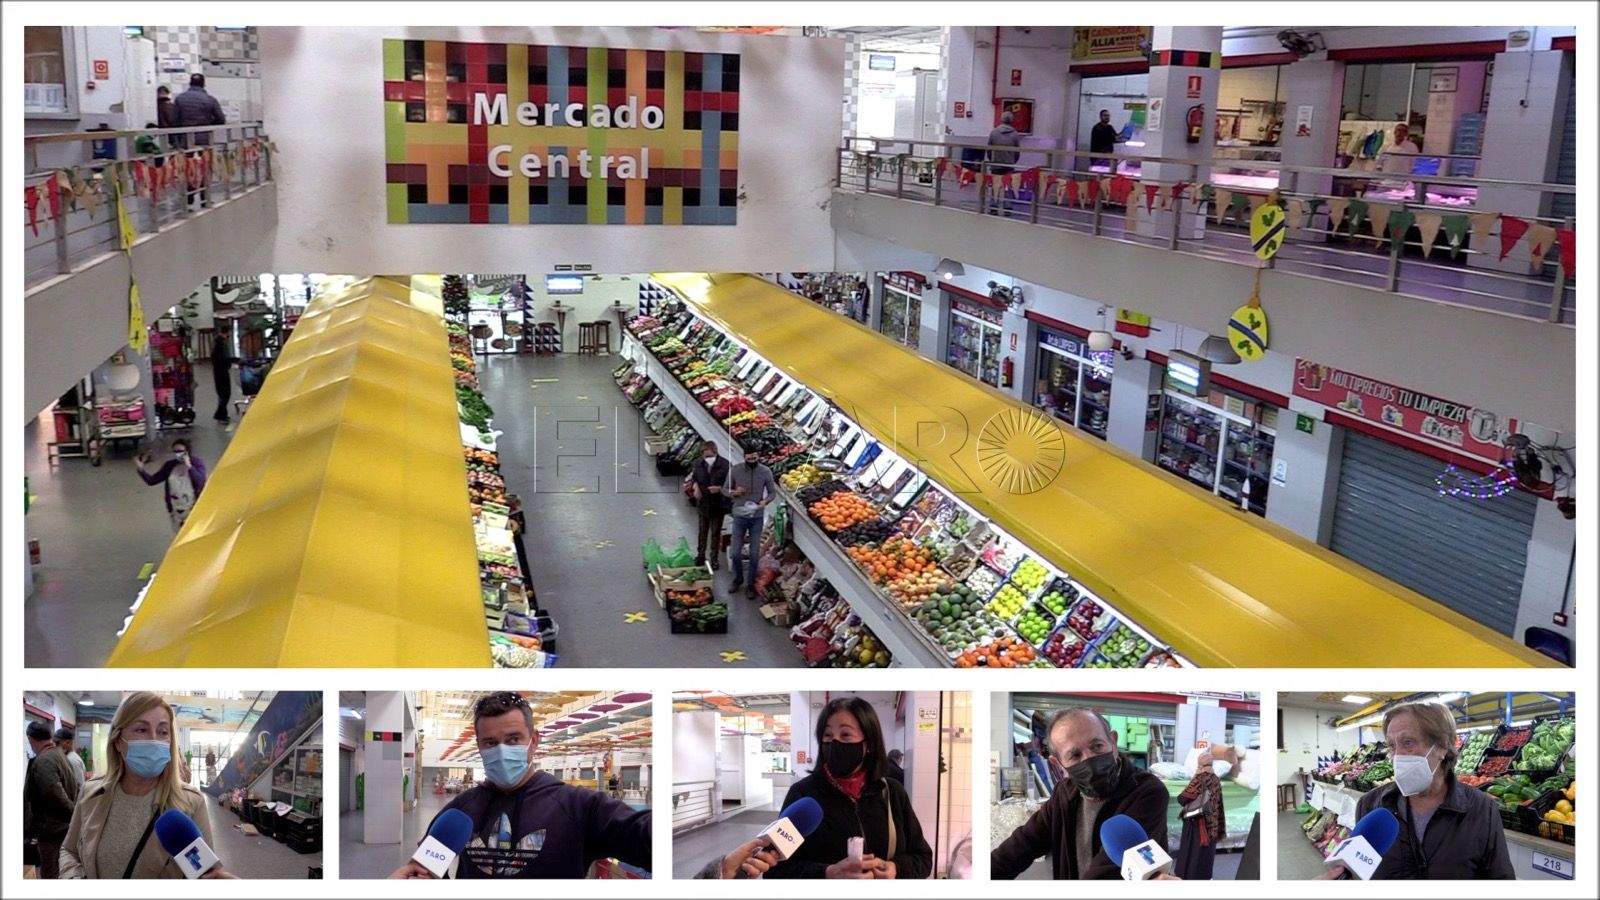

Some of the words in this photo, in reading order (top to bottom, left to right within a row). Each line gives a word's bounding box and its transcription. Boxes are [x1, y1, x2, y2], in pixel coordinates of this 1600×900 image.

[1090, 37, 1115, 47] ALIA
[473, 92, 664, 130] Mercado
[487, 144, 650, 180] Central
[1328, 367, 1396, 402] MULTIPRECIOS
[1397, 389, 1413, 407] TU
[1413, 394, 1467, 424] LIMPIEZA
[1543, 857, 1561, 871] 218
